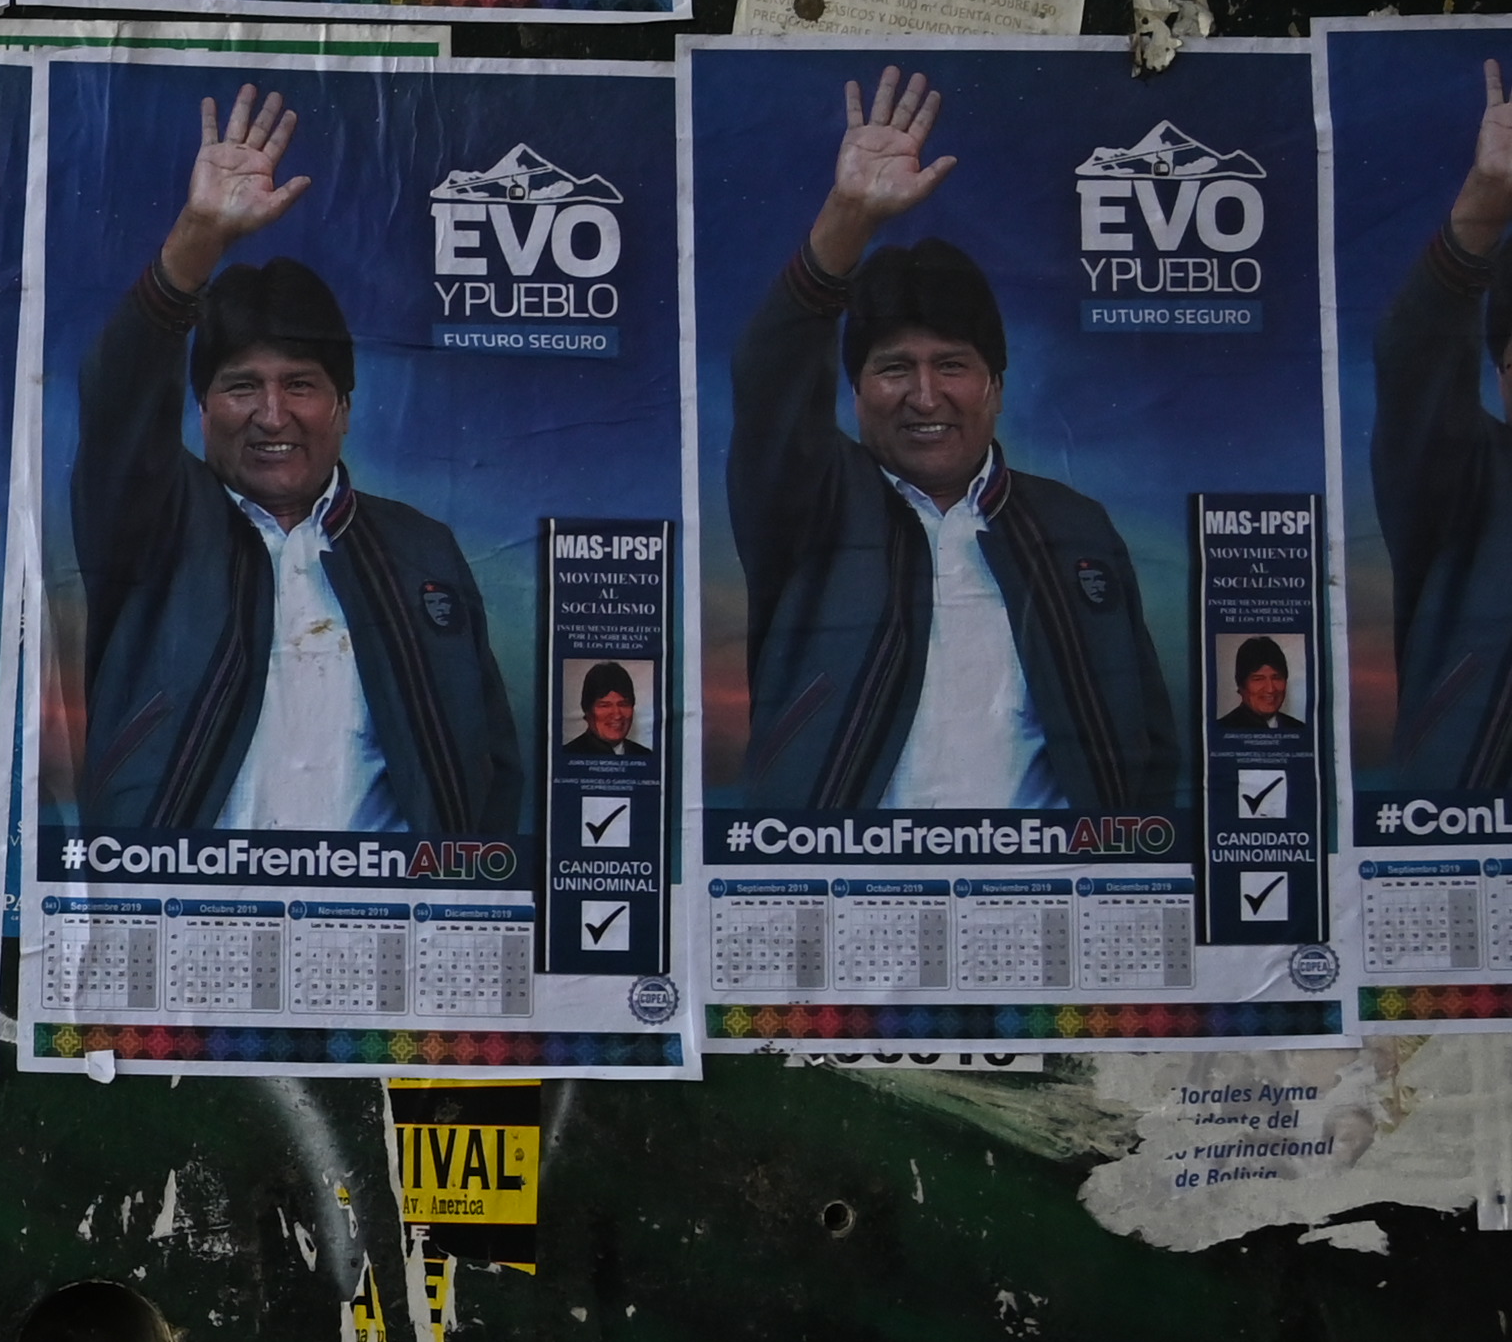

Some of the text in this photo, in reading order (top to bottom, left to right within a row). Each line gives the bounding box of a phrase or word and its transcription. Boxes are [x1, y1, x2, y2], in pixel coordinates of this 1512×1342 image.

[1076, 179, 1263, 252] EVO
[430, 202, 620, 277] EVO
[727, 817, 1175, 855] #ConLaFrenteEnALTO
[60, 835, 517, 881] #ConLaFrenteEnALTO
[1176, 1085, 1252, 1104] orales
[431, 1195, 485, 1215] America
